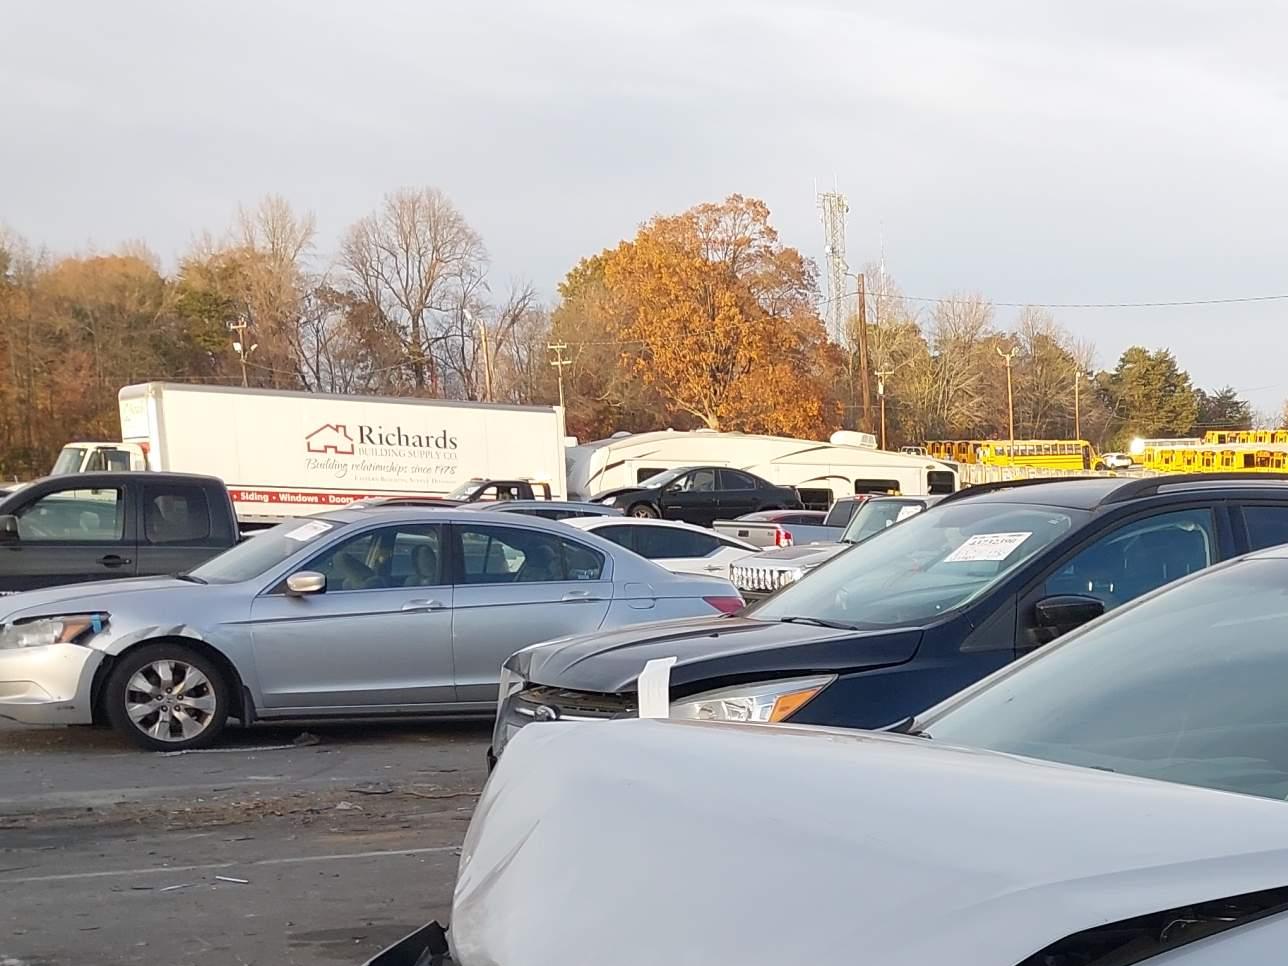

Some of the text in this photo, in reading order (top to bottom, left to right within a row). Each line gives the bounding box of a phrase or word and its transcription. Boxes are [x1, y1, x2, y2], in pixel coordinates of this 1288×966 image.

[358, 424, 458, 450] Richards
[358, 447, 406, 458] BUILDING
[408, 449, 441, 460] SUPPLY
[305, 457, 348, 478] Building
[351, 460, 408, 477] relationships
[410, 462, 432, 474] since
[240, 491, 269, 503] Siding
[278, 492, 319, 503] Windows
